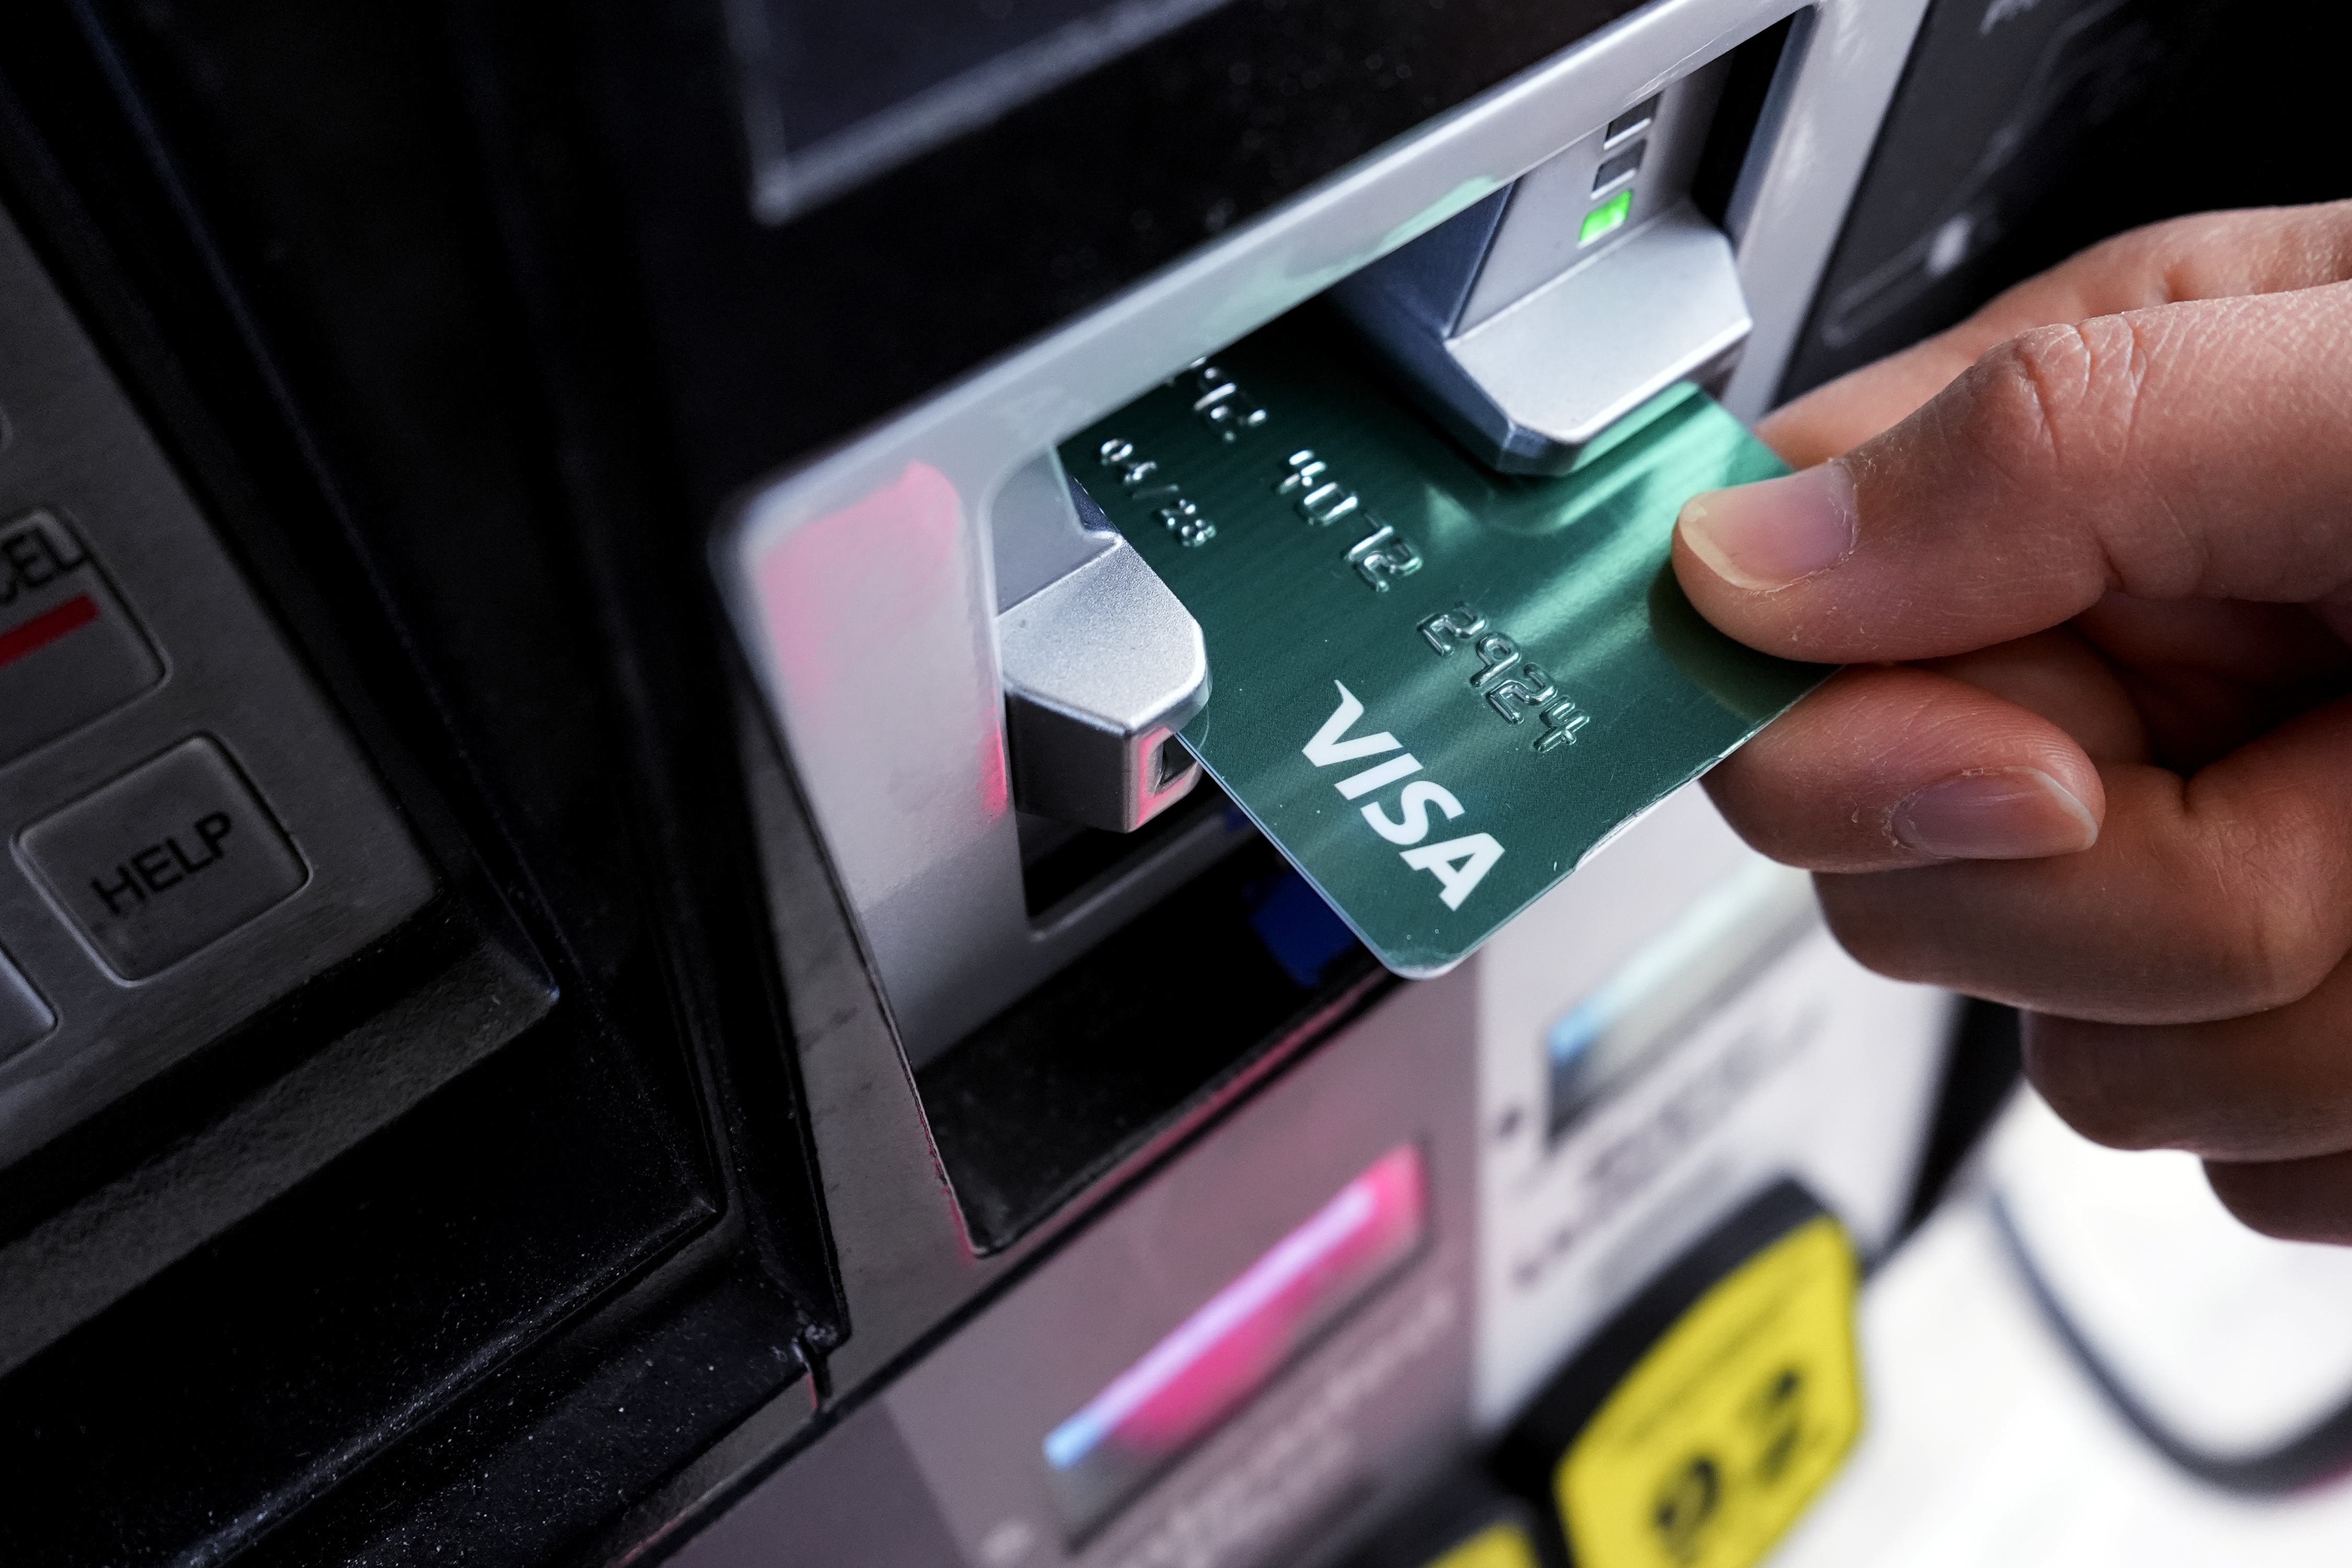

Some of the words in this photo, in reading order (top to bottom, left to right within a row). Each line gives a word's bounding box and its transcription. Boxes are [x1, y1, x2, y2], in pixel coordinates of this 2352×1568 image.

[1277, 449, 1424, 593] 4072
[1415, 603, 1590, 754] 2924
[91, 812, 231, 917] HELP
[1302, 679, 1505, 912] VISA
